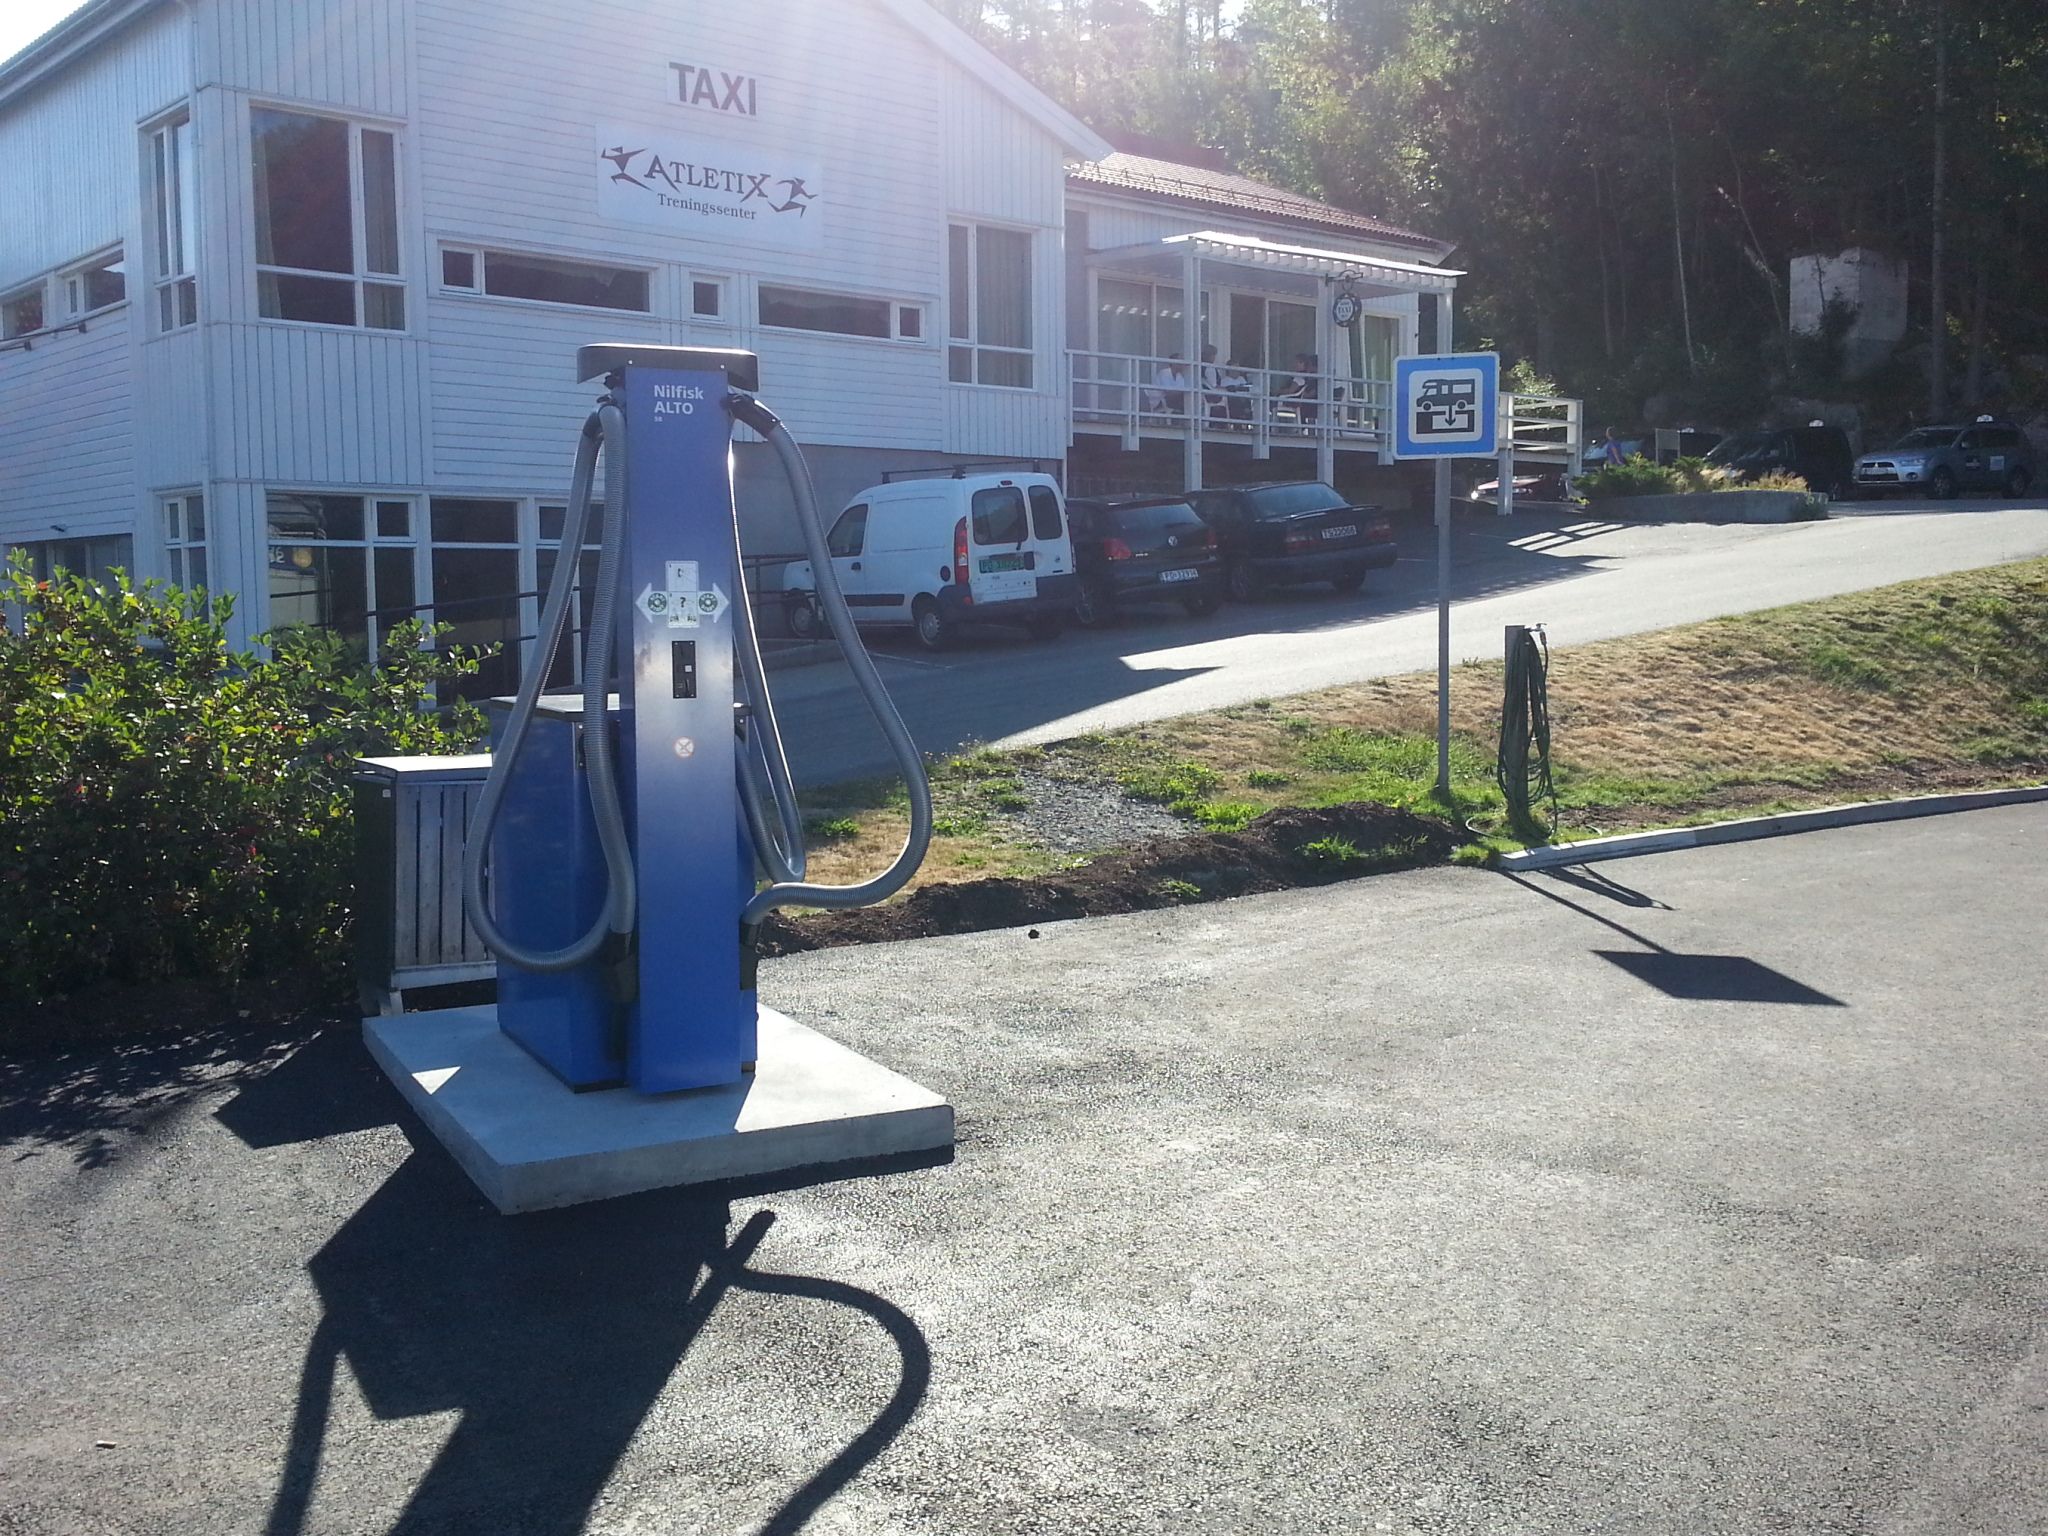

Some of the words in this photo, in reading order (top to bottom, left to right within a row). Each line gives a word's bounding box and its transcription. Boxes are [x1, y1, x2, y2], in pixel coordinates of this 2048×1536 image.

[668, 61, 757, 116] TAXI
[643, 154, 772, 203] ATLETIX
[657, 193, 757, 220] Treningssenter
[654, 384, 704, 400] Nilfisk
[654, 400, 694, 415] ALTO
